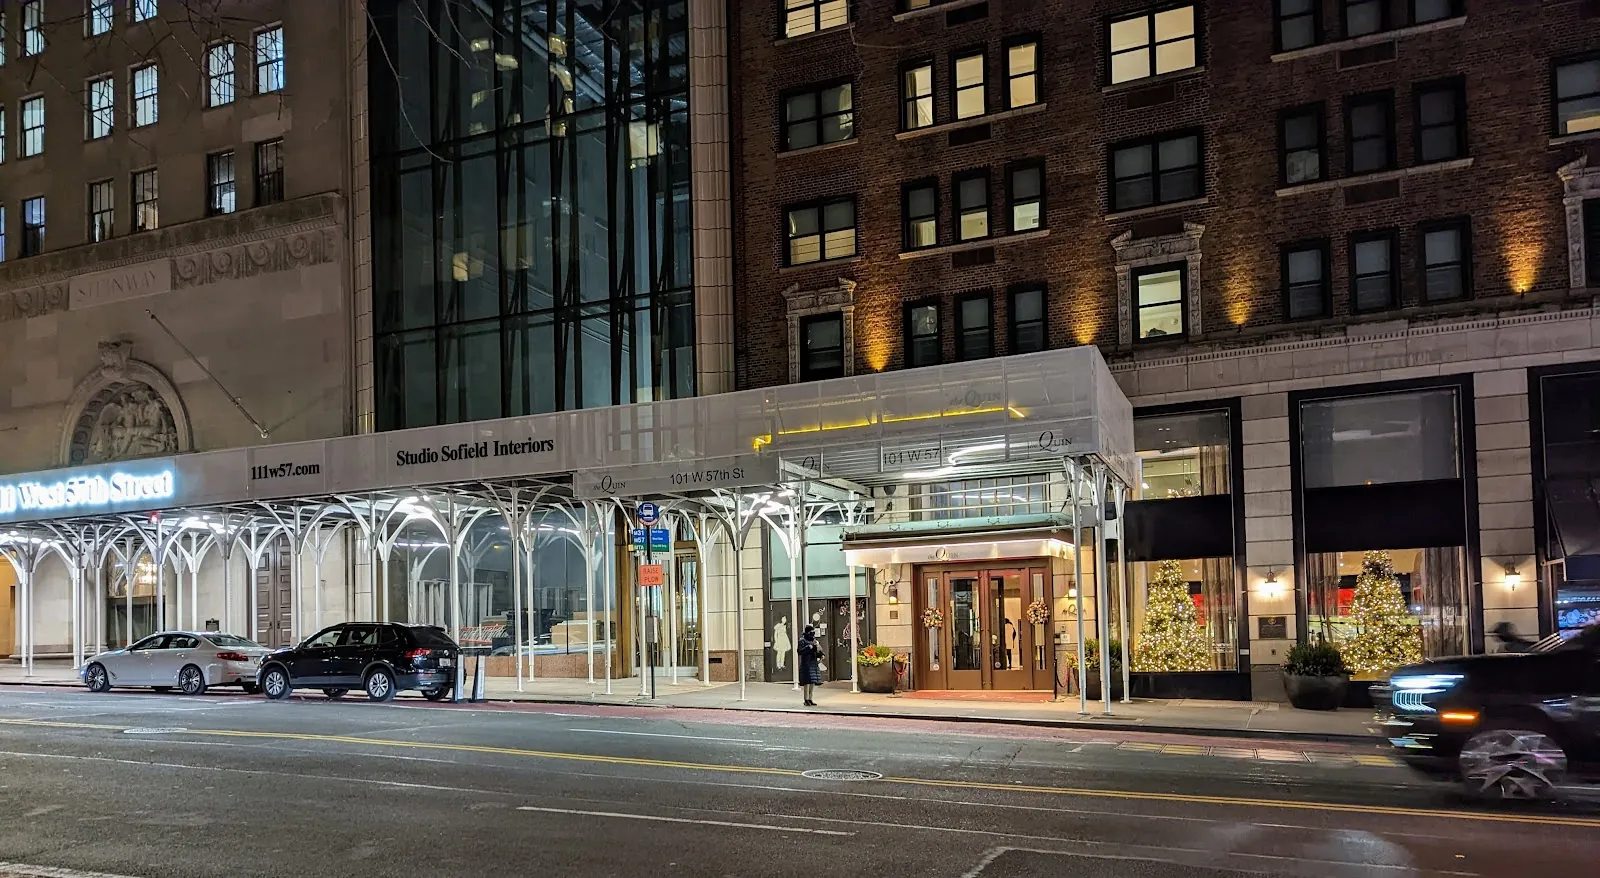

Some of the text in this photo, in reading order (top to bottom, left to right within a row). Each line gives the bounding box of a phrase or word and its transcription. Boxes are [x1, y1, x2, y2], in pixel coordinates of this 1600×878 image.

[77, 269, 157, 302] STEINWAY
[1038, 430, 1073, 452] QUIN
[396, 437, 554, 467] Studio Sofield Interiors
[883, 452, 903, 465] 101
[907, 450, 921, 462] W
[251, 462, 320, 480] 111w57.com
[669, 467, 745, 485] 101 W 57th St
[18, 482, 65, 508] West
[66, 475, 109, 506] 57th
[111, 470, 173, 502] Street
[601, 475, 626, 494] QUIN
[935, 547, 959, 562] QUIN
